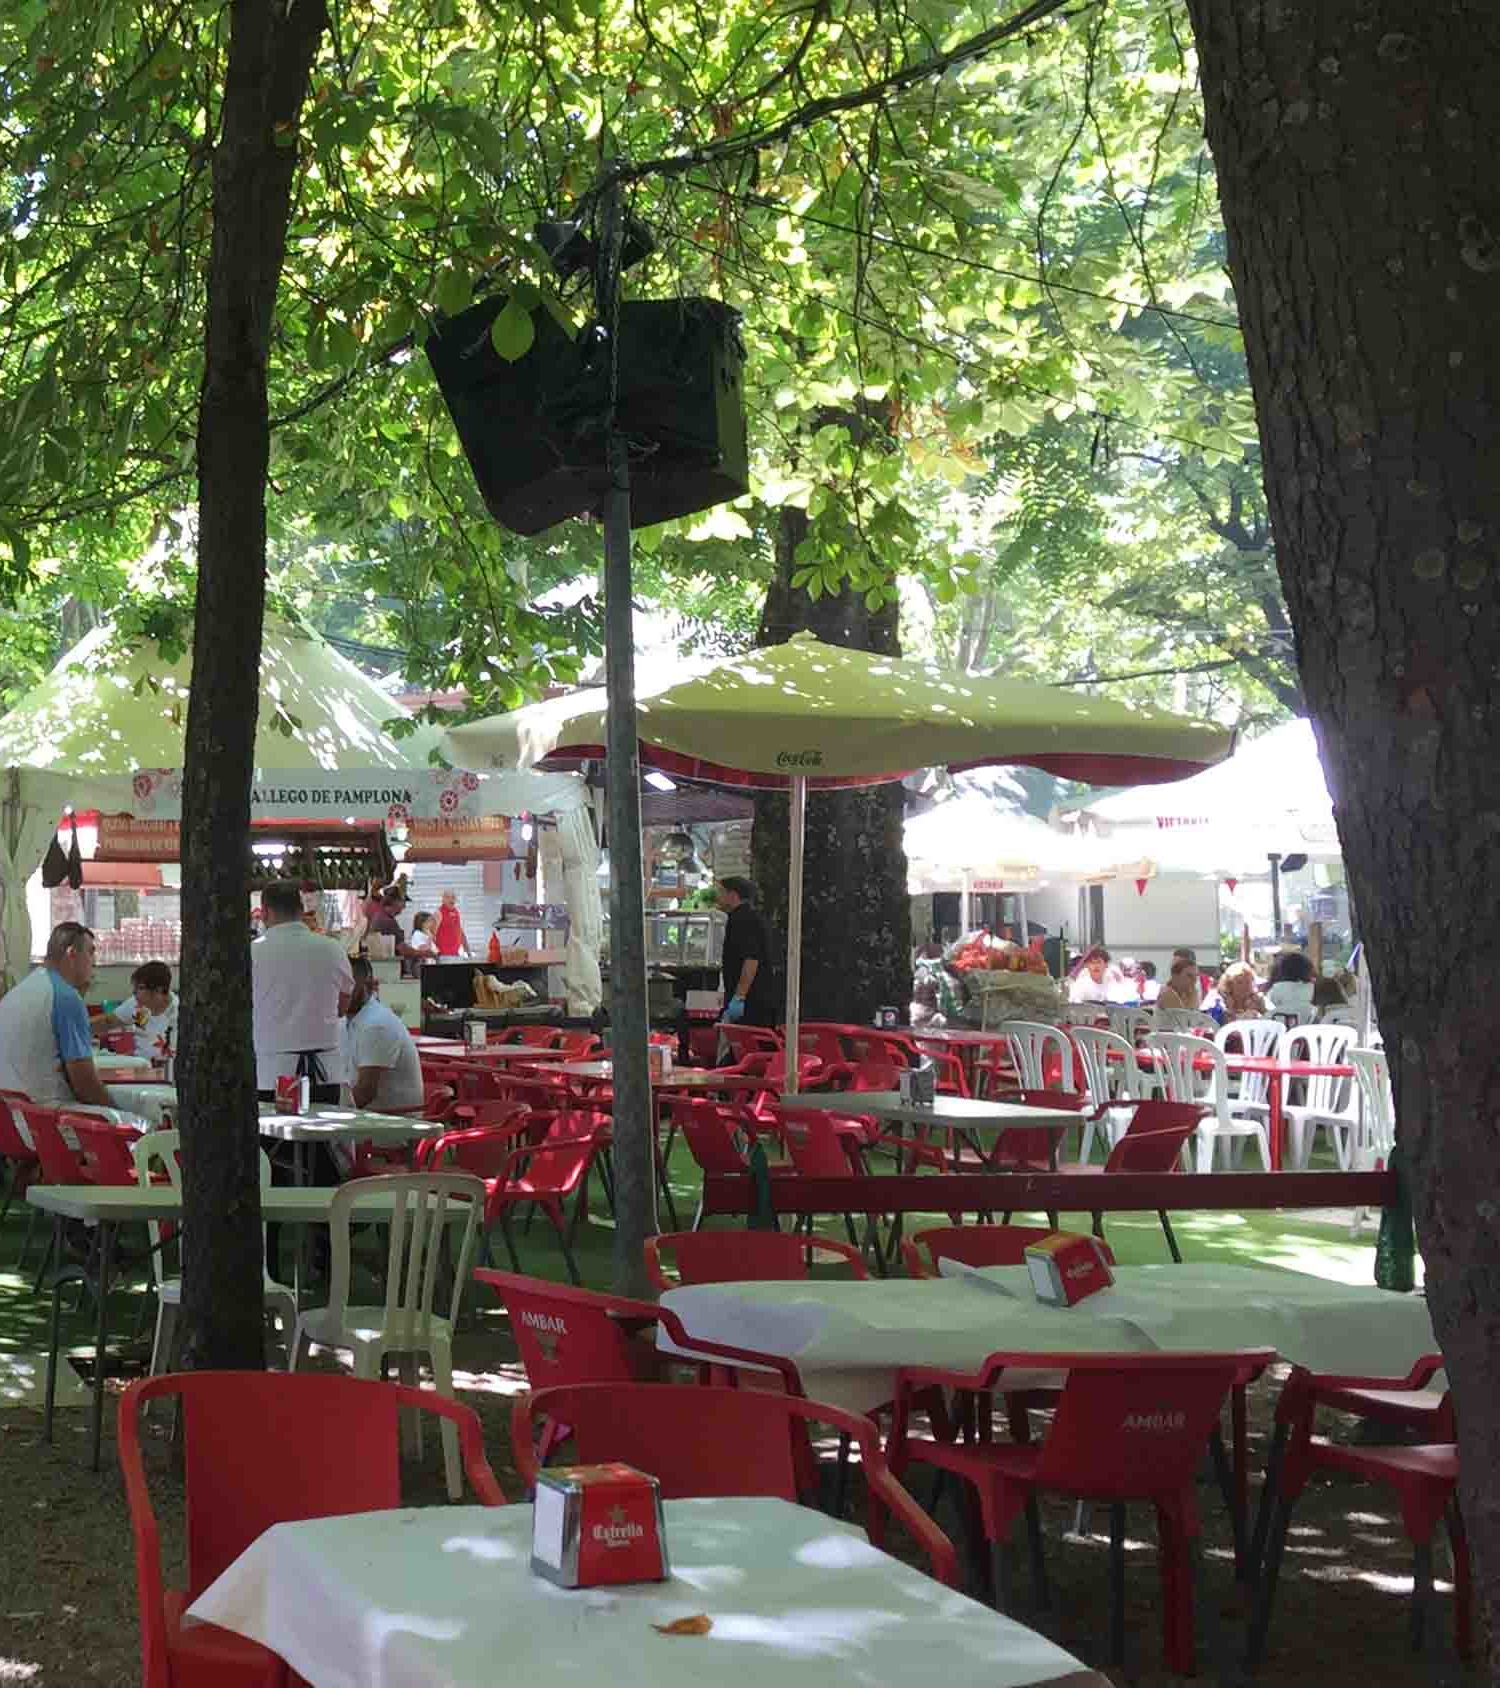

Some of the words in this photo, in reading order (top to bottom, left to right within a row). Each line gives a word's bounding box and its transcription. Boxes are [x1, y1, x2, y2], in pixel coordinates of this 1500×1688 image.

[251, 789, 308, 804] ALLEGO
[312, 789, 331, 804] DE
[334, 789, 412, 804] PAMPLONA
[521, 1309, 569, 1335] AMBAR
[1122, 1410, 1188, 1429] AMBAR
[592, 1521, 644, 1541] Estrella
